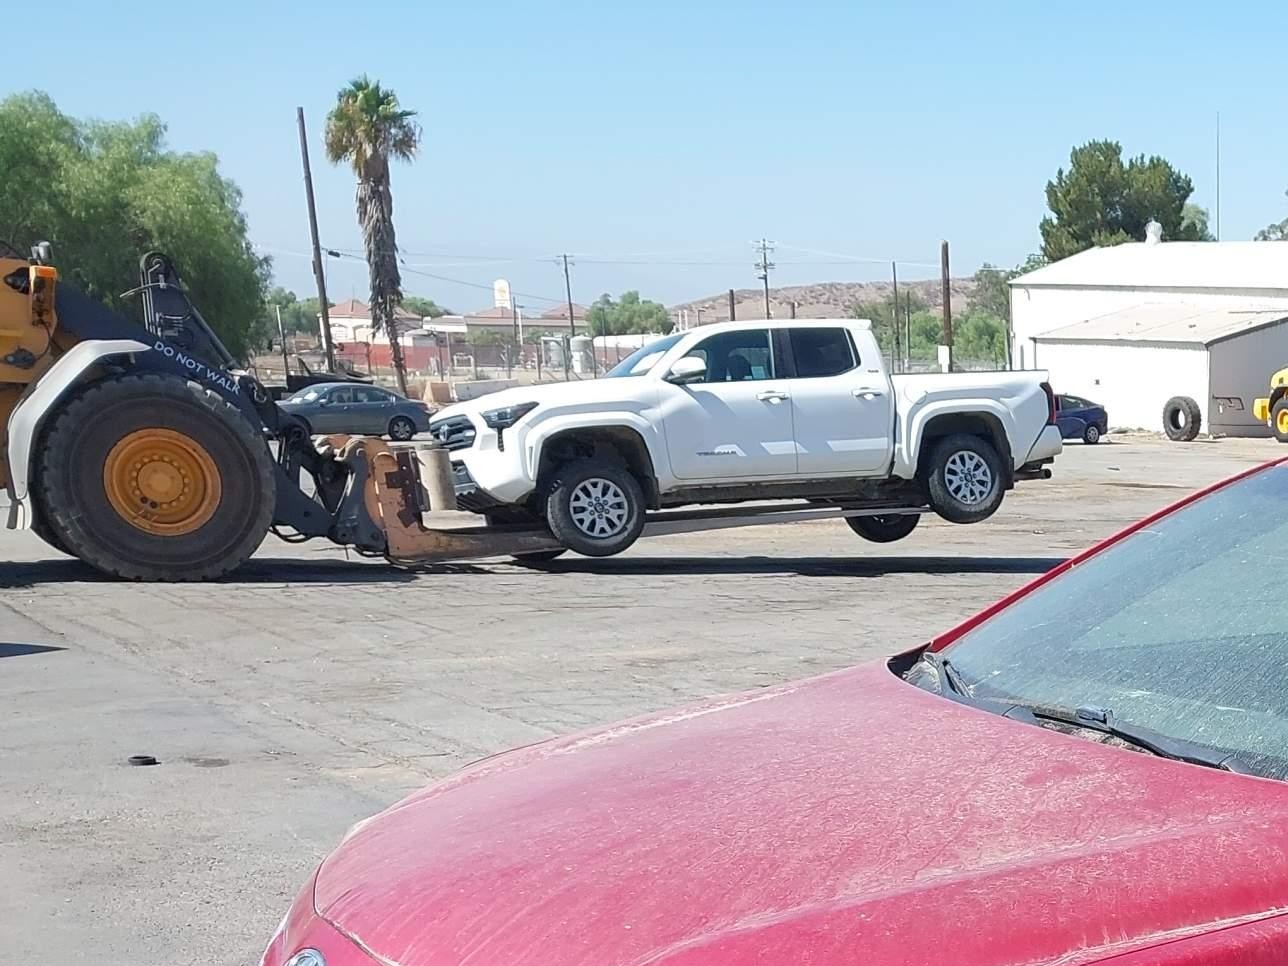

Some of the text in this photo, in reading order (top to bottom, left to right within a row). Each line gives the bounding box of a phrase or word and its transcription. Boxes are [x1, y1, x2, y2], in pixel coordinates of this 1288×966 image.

[154, 341, 241, 396] DO NOT WALK
